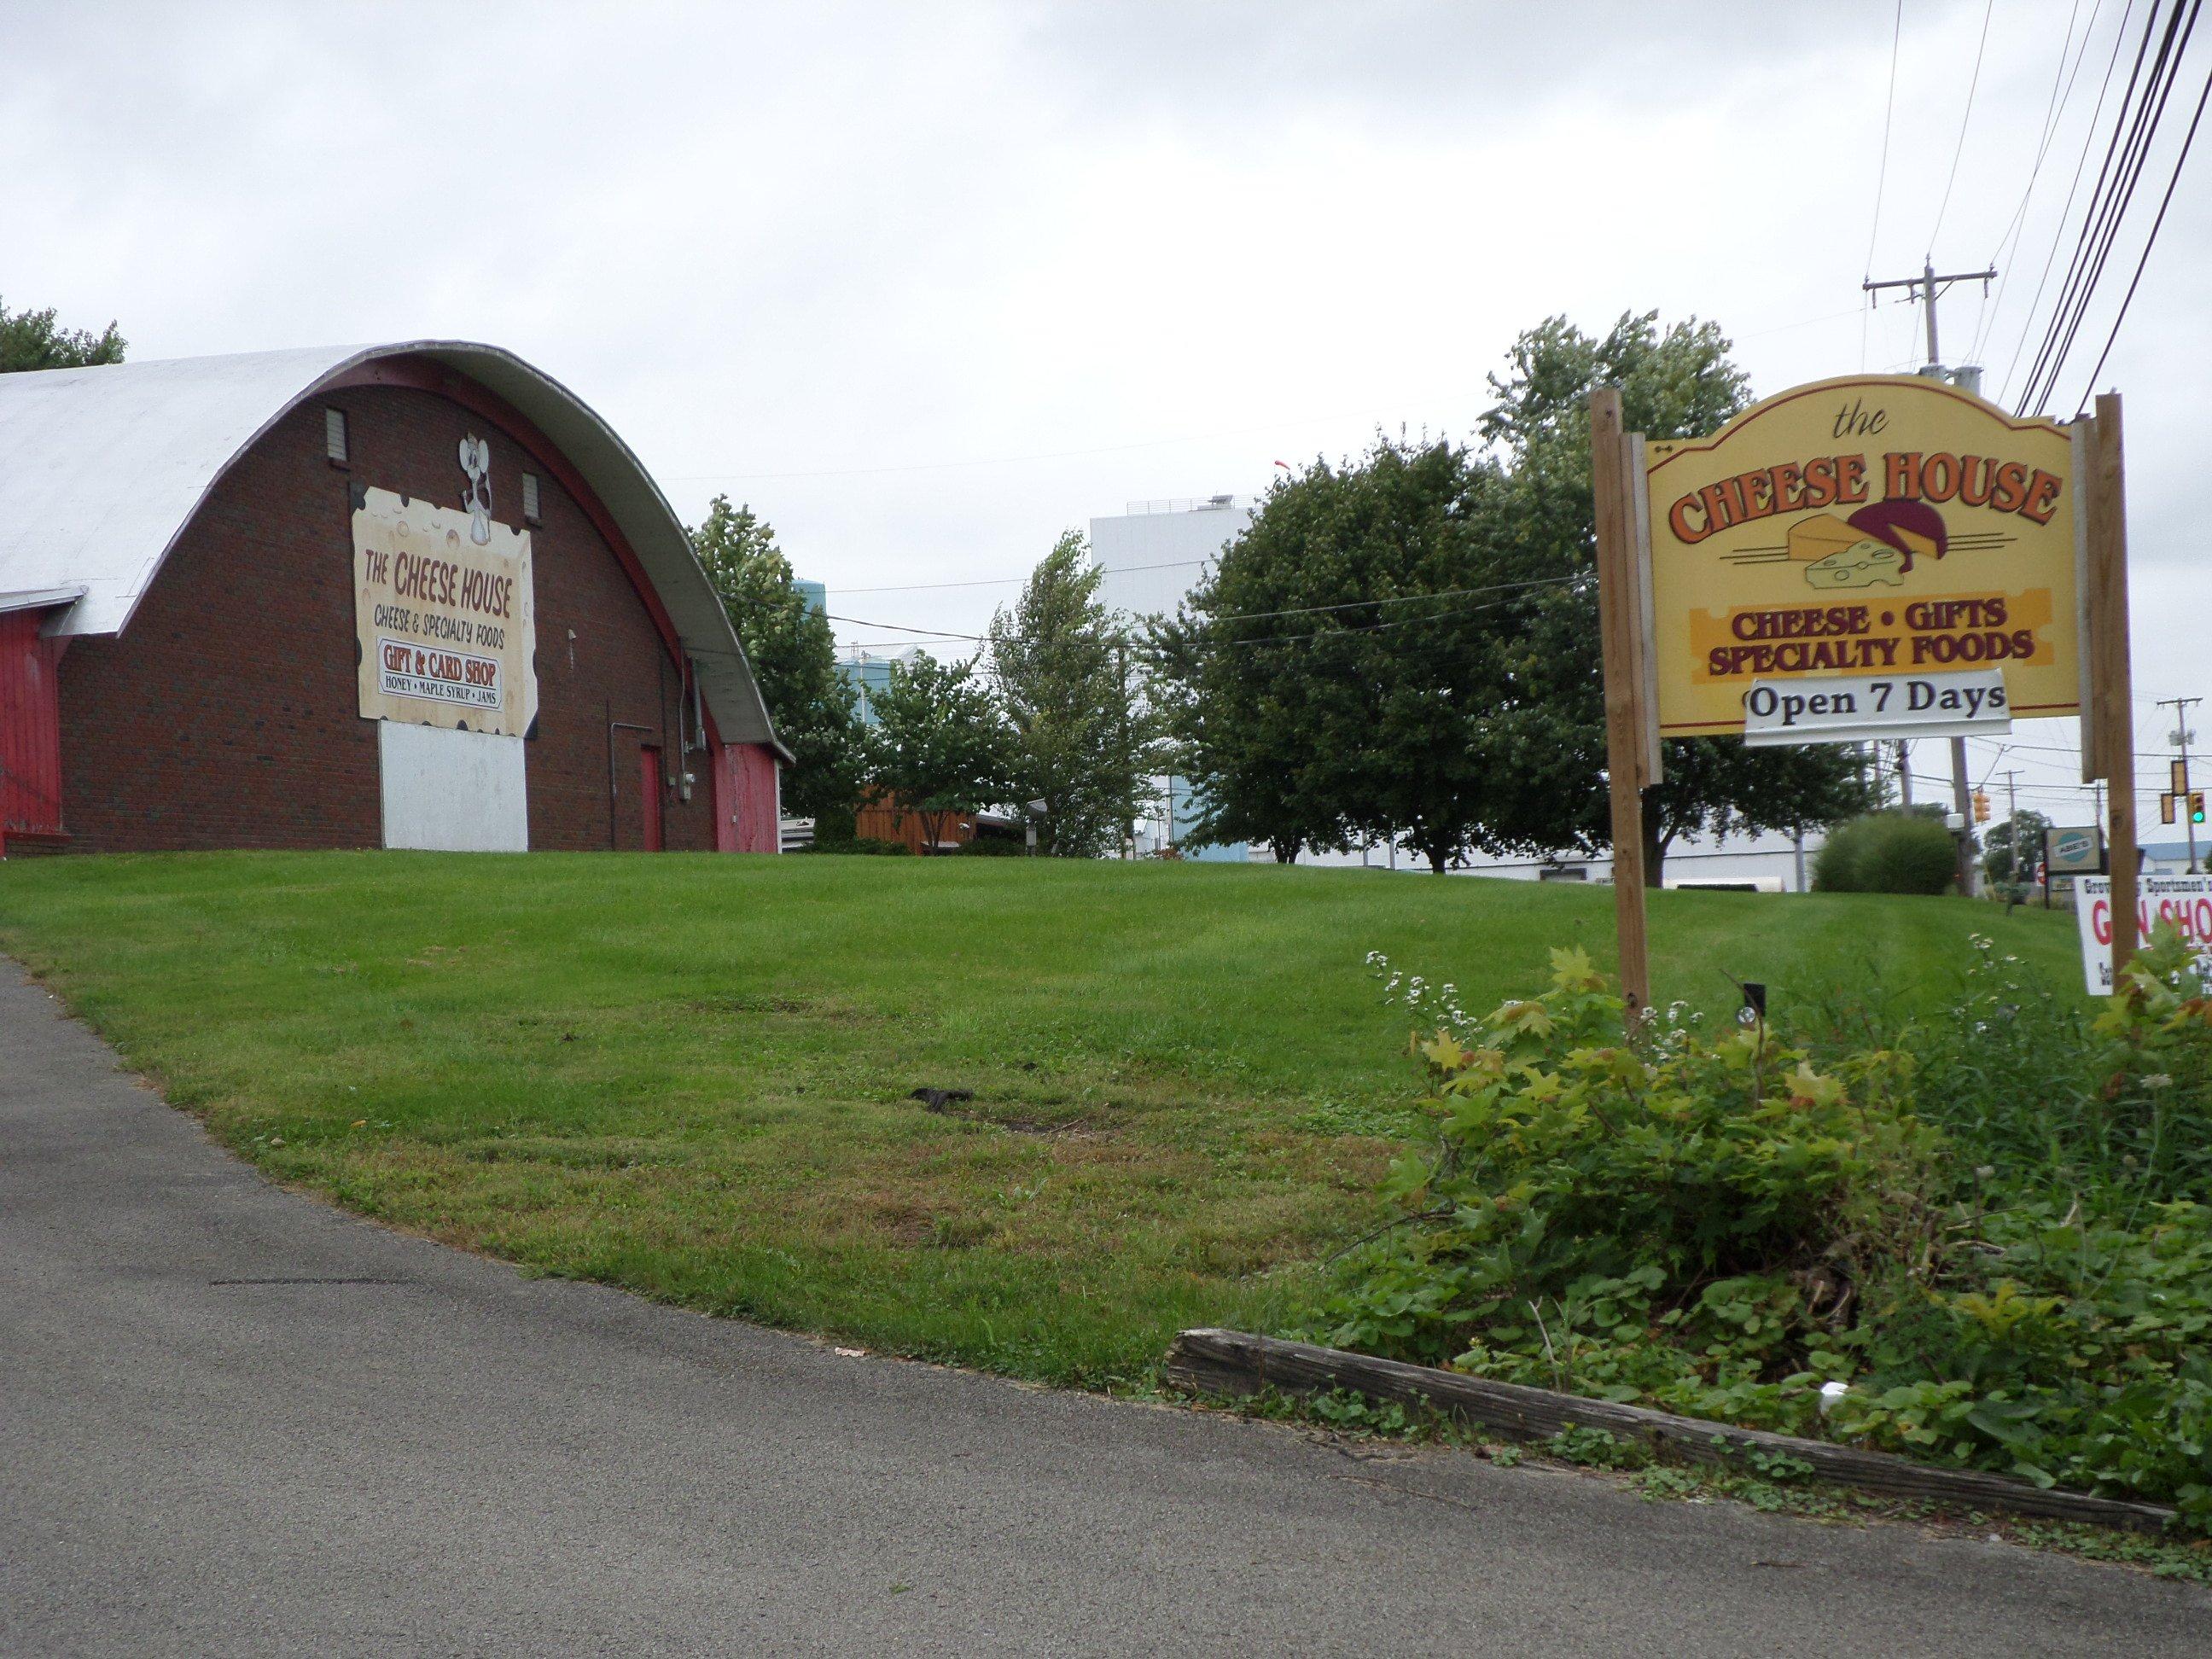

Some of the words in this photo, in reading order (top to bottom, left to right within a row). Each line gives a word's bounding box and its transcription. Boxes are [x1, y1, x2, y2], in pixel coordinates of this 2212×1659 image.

[1831, 396, 1891, 439] the
[1668, 452, 1871, 544] CHEESE
[1883, 451, 2064, 527] HOUSE
[365, 549, 389, 585] THE
[394, 551, 458, 607] CHEESE
[461, 567, 513, 619] HOUSE
[375, 603, 411, 633] CHEESE
[412, 613, 420, 634] &
[422, 614, 473, 643] SPECIALTY
[476, 623, 505, 650] FOODS
[1731, 604, 1870, 642] CHEESE
[1905, 597, 2008, 632] GIFTS
[384, 643, 412, 673] GIFT
[415, 649, 426, 676] &
[428, 652, 463, 682] CARD
[465, 658, 497, 687] SHOP
[1708, 637, 1901, 677] SPECIALTY
[1912, 628, 2036, 665] FOODS
[385, 675, 412, 691] HONEY
[419, 680, 445, 696] MAPLE
[446, 684, 471, 701] SYRUP
[477, 690, 497, 704] JAMS
[1748, 684, 1856, 725] Open
[1870, 681, 1893, 713] 7
[1906, 679, 2007, 720] Days
[2093, 899, 2150, 946] GN
